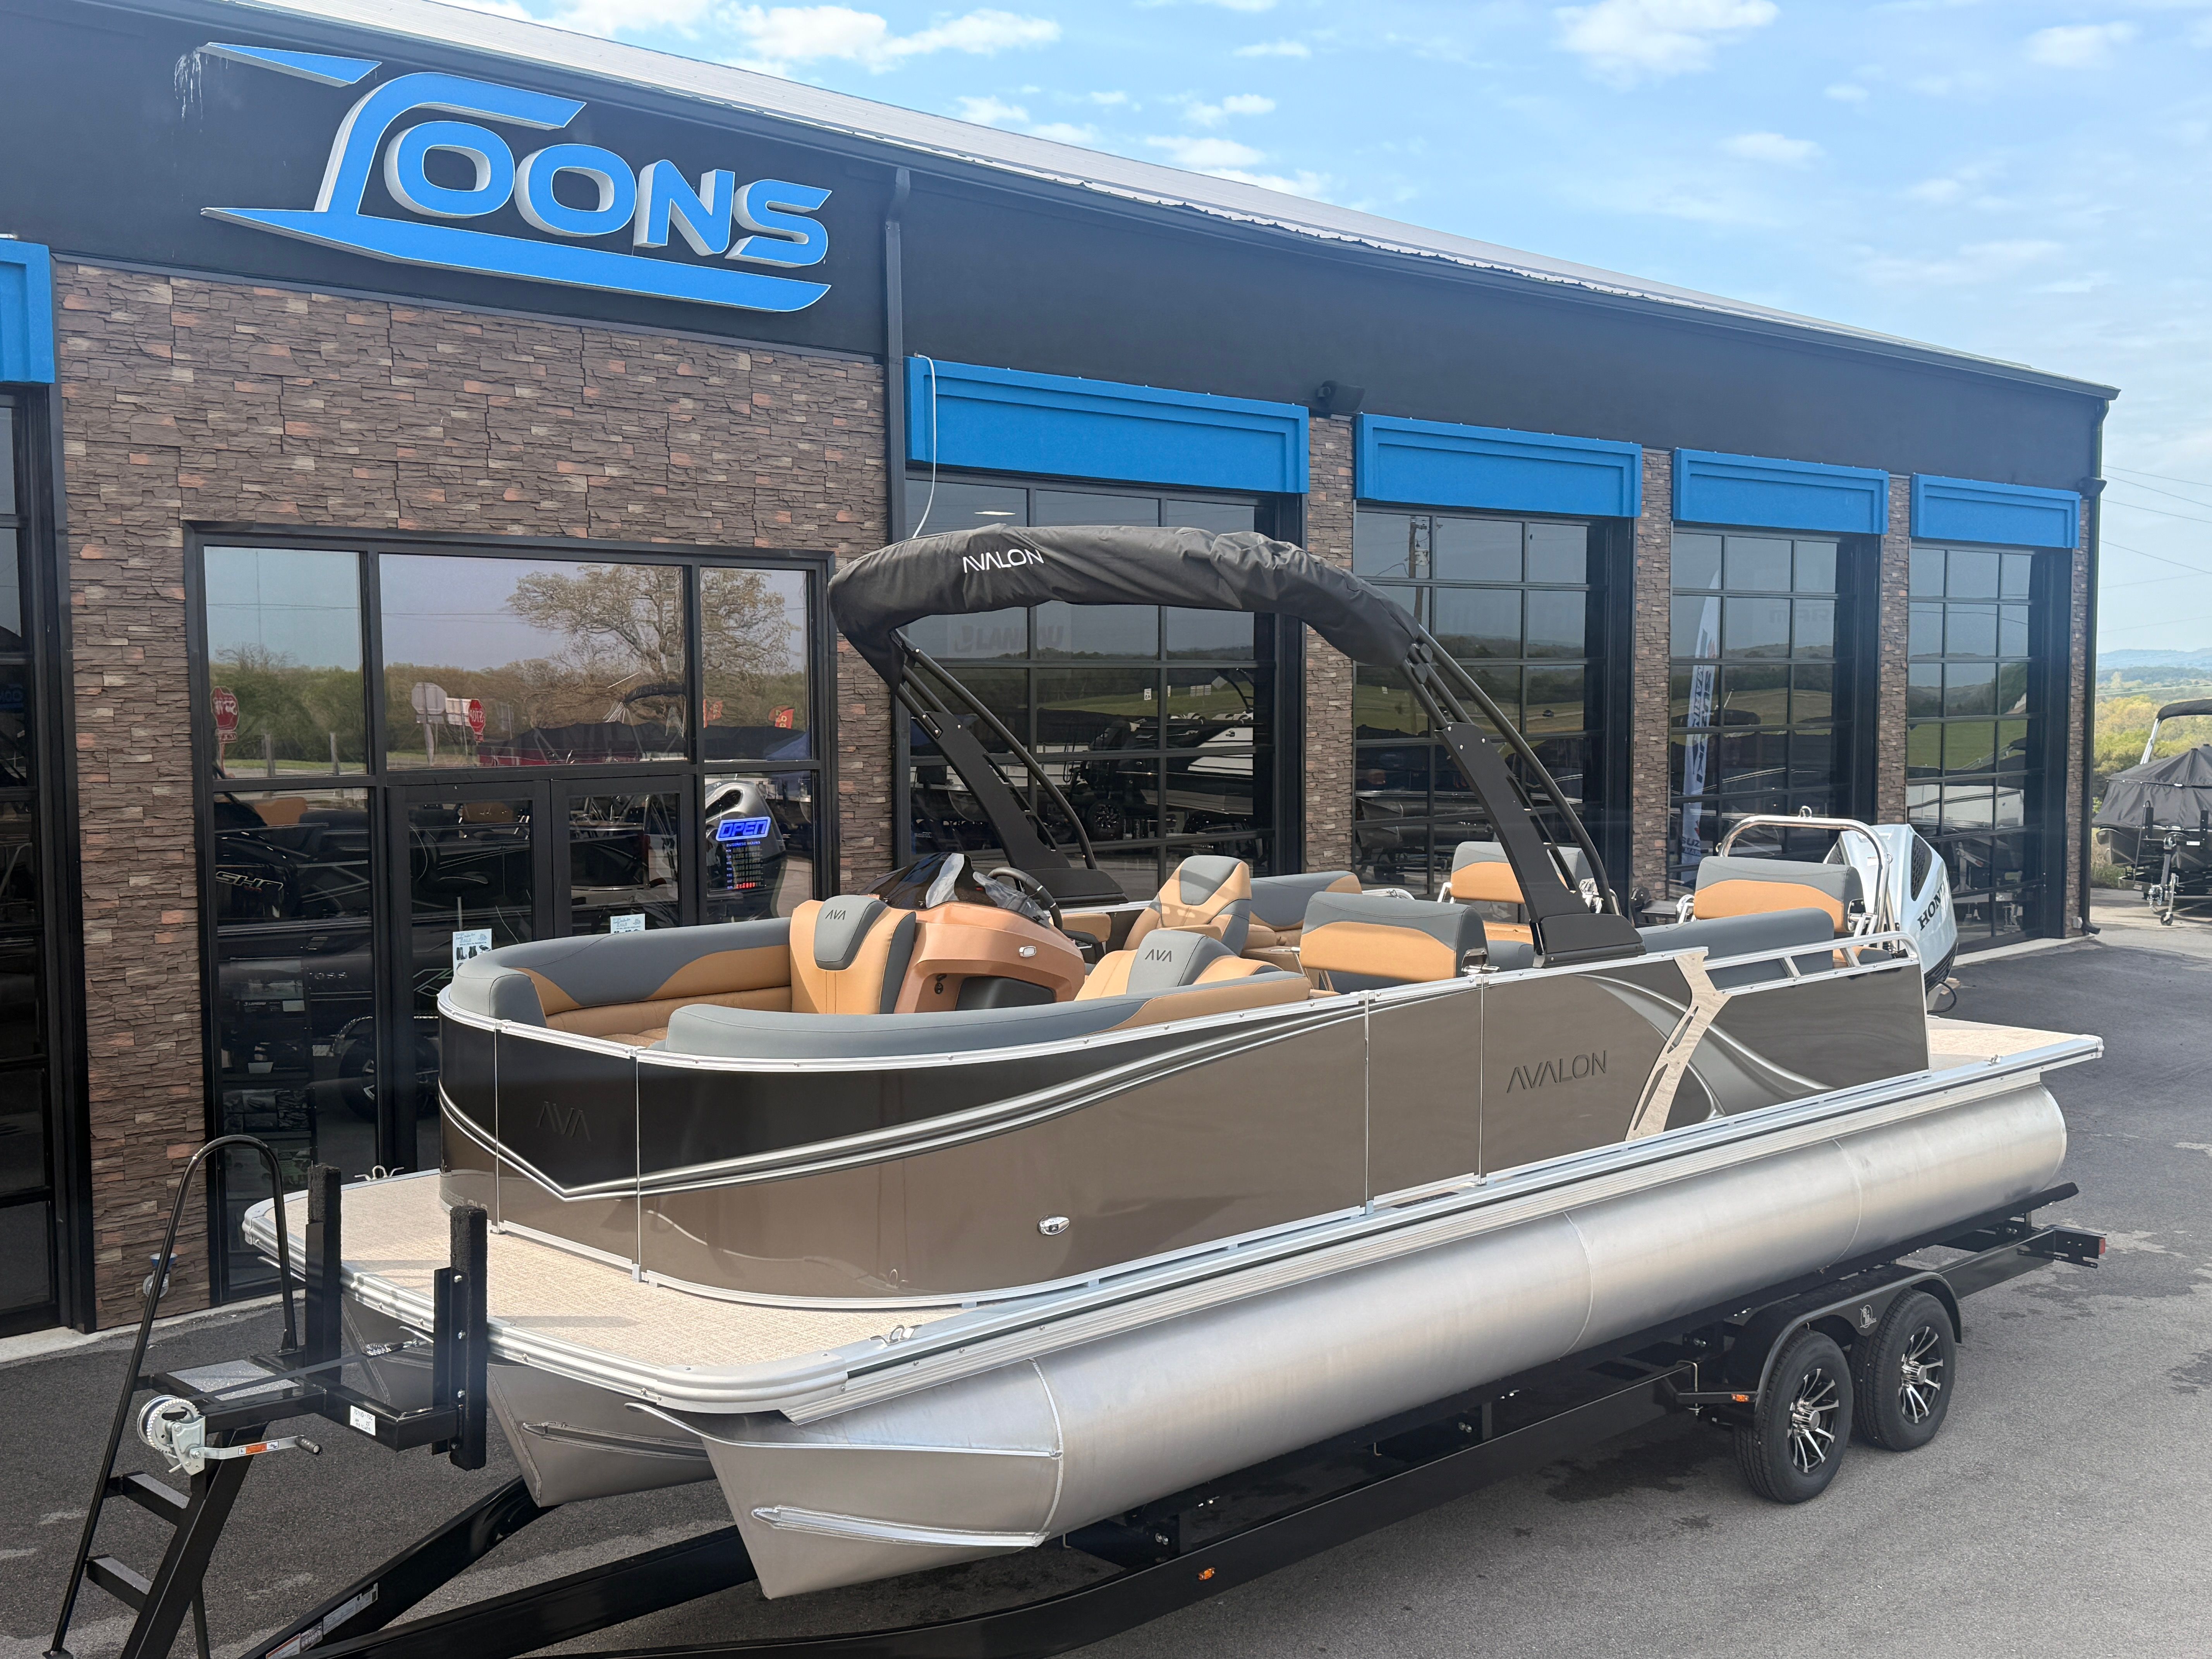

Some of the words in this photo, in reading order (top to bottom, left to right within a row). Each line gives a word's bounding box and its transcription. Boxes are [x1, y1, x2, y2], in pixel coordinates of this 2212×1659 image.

[963, 548, 1044, 573] AVALON
[975, 625, 1065, 651] LANAU
[720, 821, 768, 838] OPEN
[825, 909, 846, 921] AVA
[1917, 881, 1946, 931] HON
[1145, 949, 1172, 962] AVA
[1506, 1050, 1607, 1094] AVALON
[536, 1101, 592, 1142] AVA
